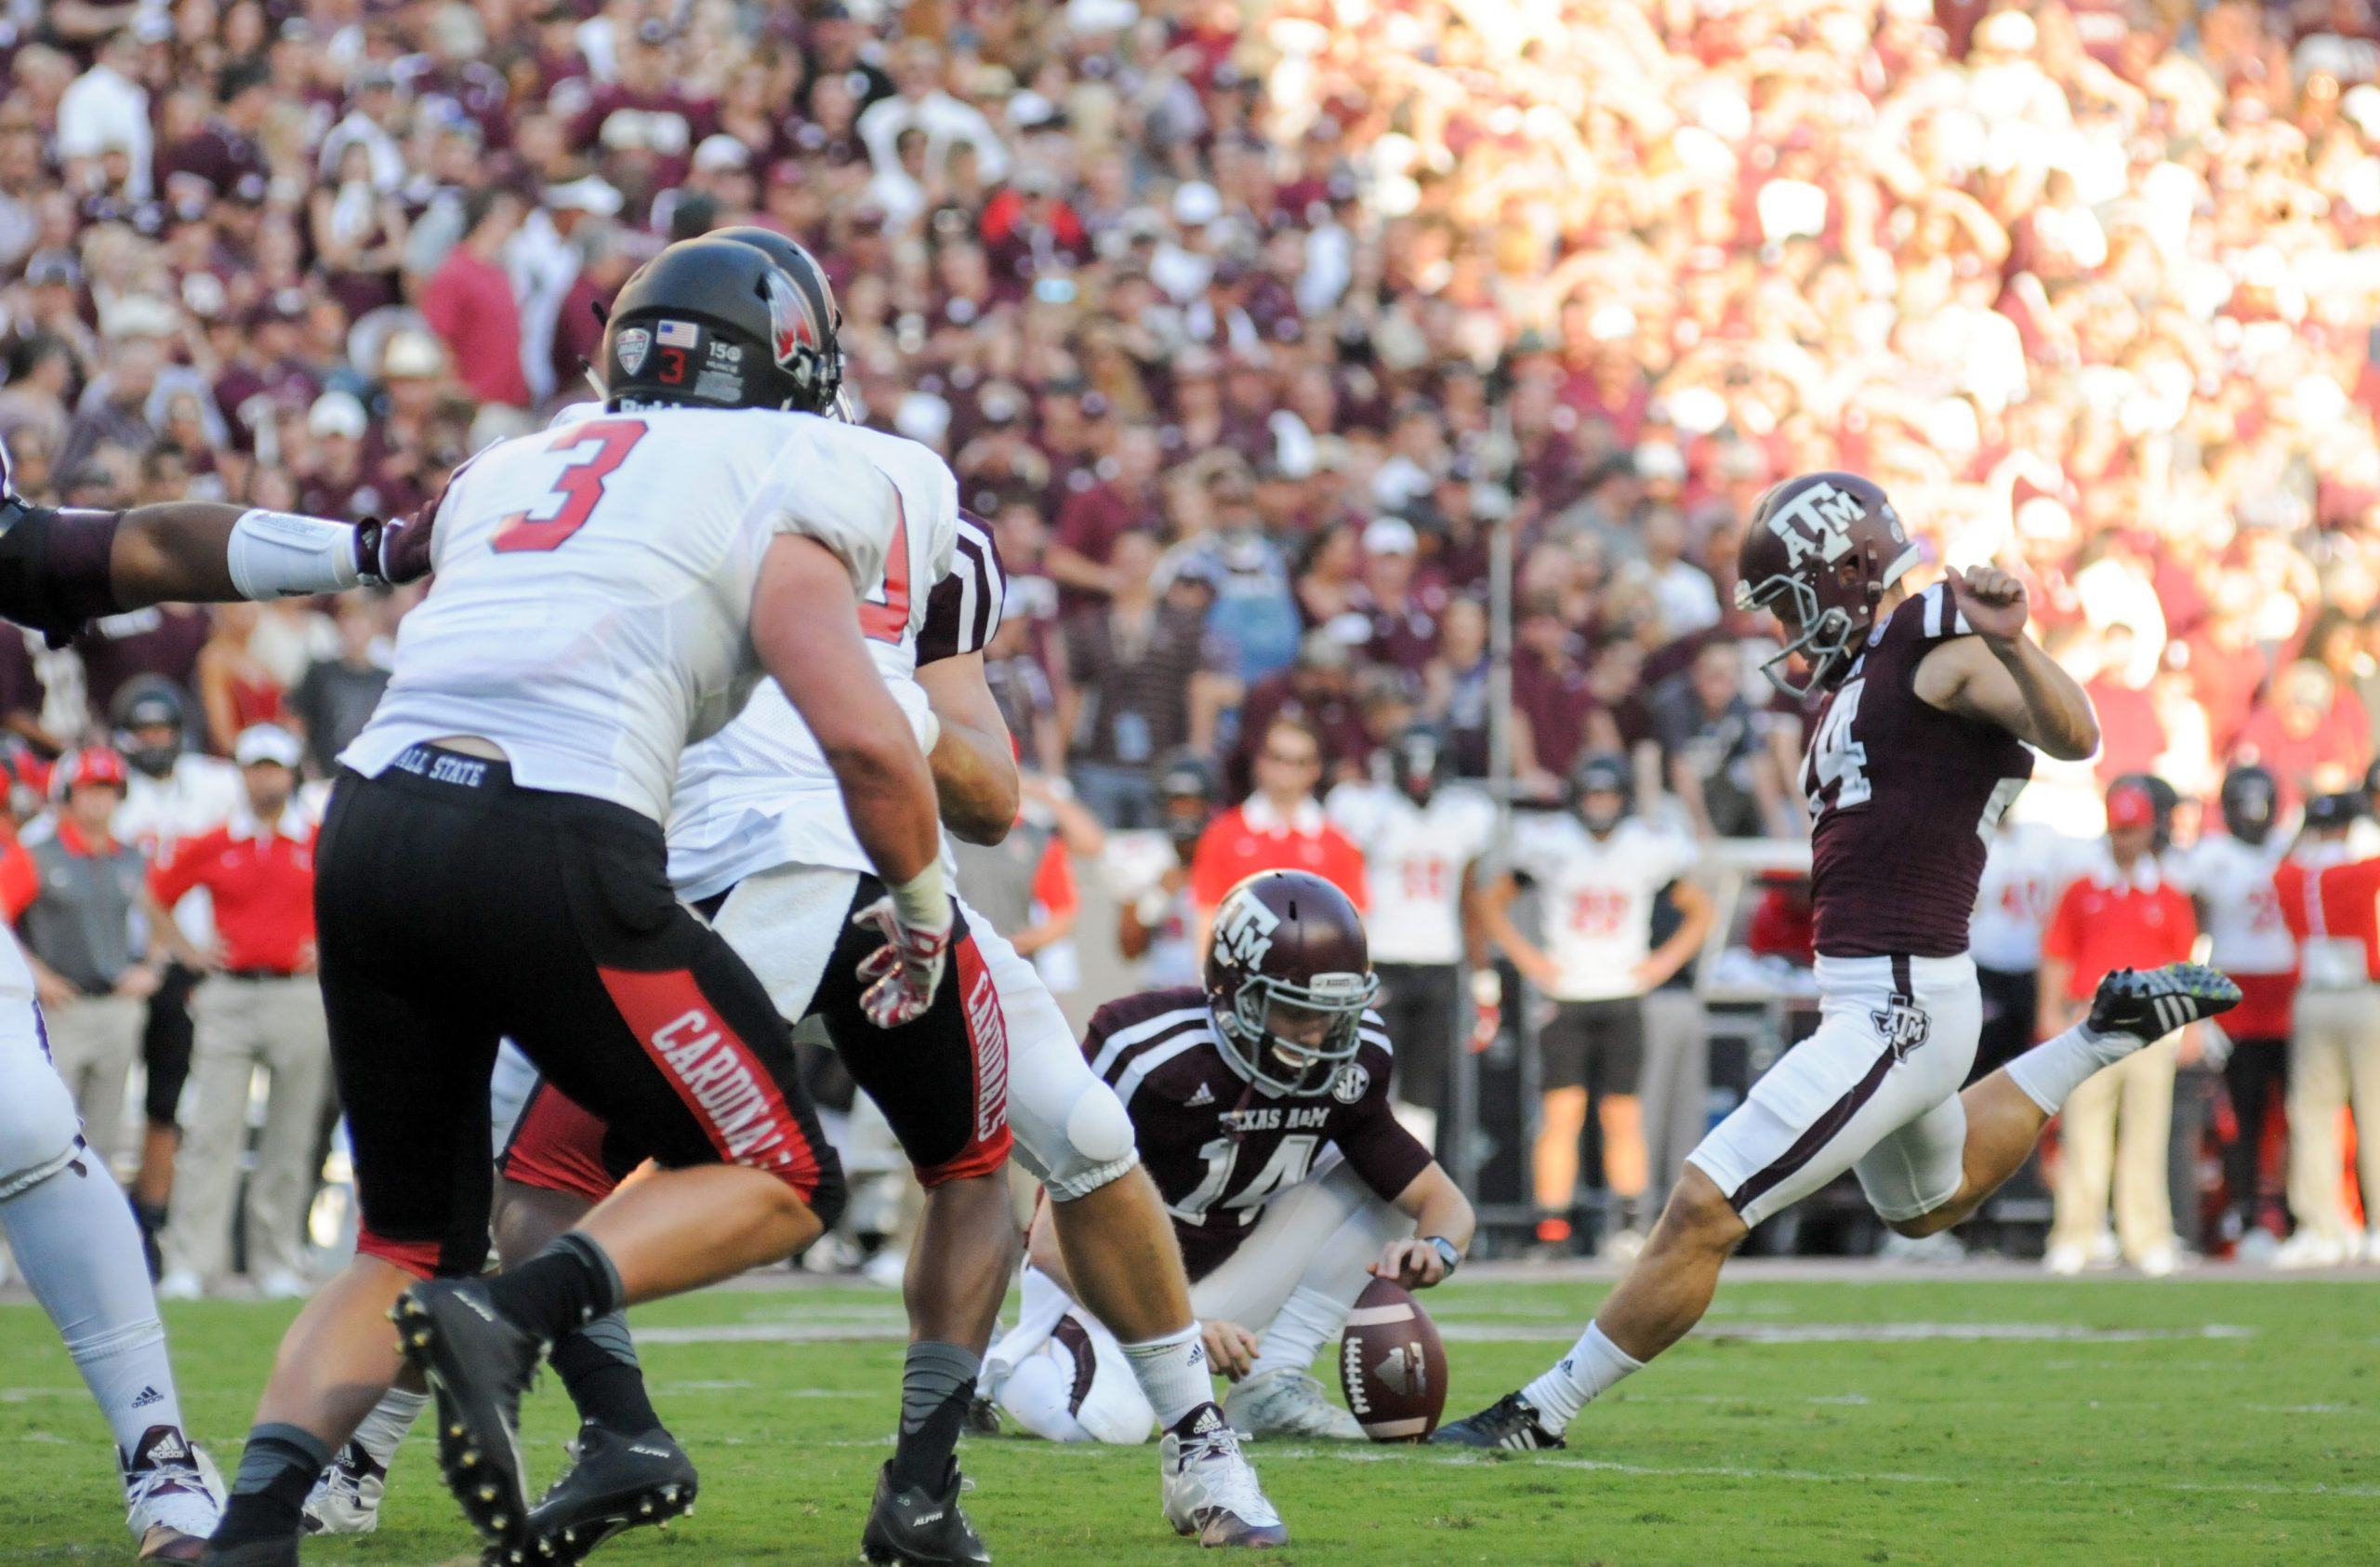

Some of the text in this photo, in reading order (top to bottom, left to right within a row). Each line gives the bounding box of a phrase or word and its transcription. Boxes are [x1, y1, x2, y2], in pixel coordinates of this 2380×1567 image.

[658, 347, 685, 384] 3
[488, 419, 649, 554] 3
[394, 748, 487, 787] ALL STATE
[968, 970, 1007, 1142] CARDINALS
[1285, 1107, 1331, 1129] A&M
[1167, 1135, 1319, 1227] 14
[132, 1394, 165, 1408] adidas
[146, 1451, 185, 1459] didas
